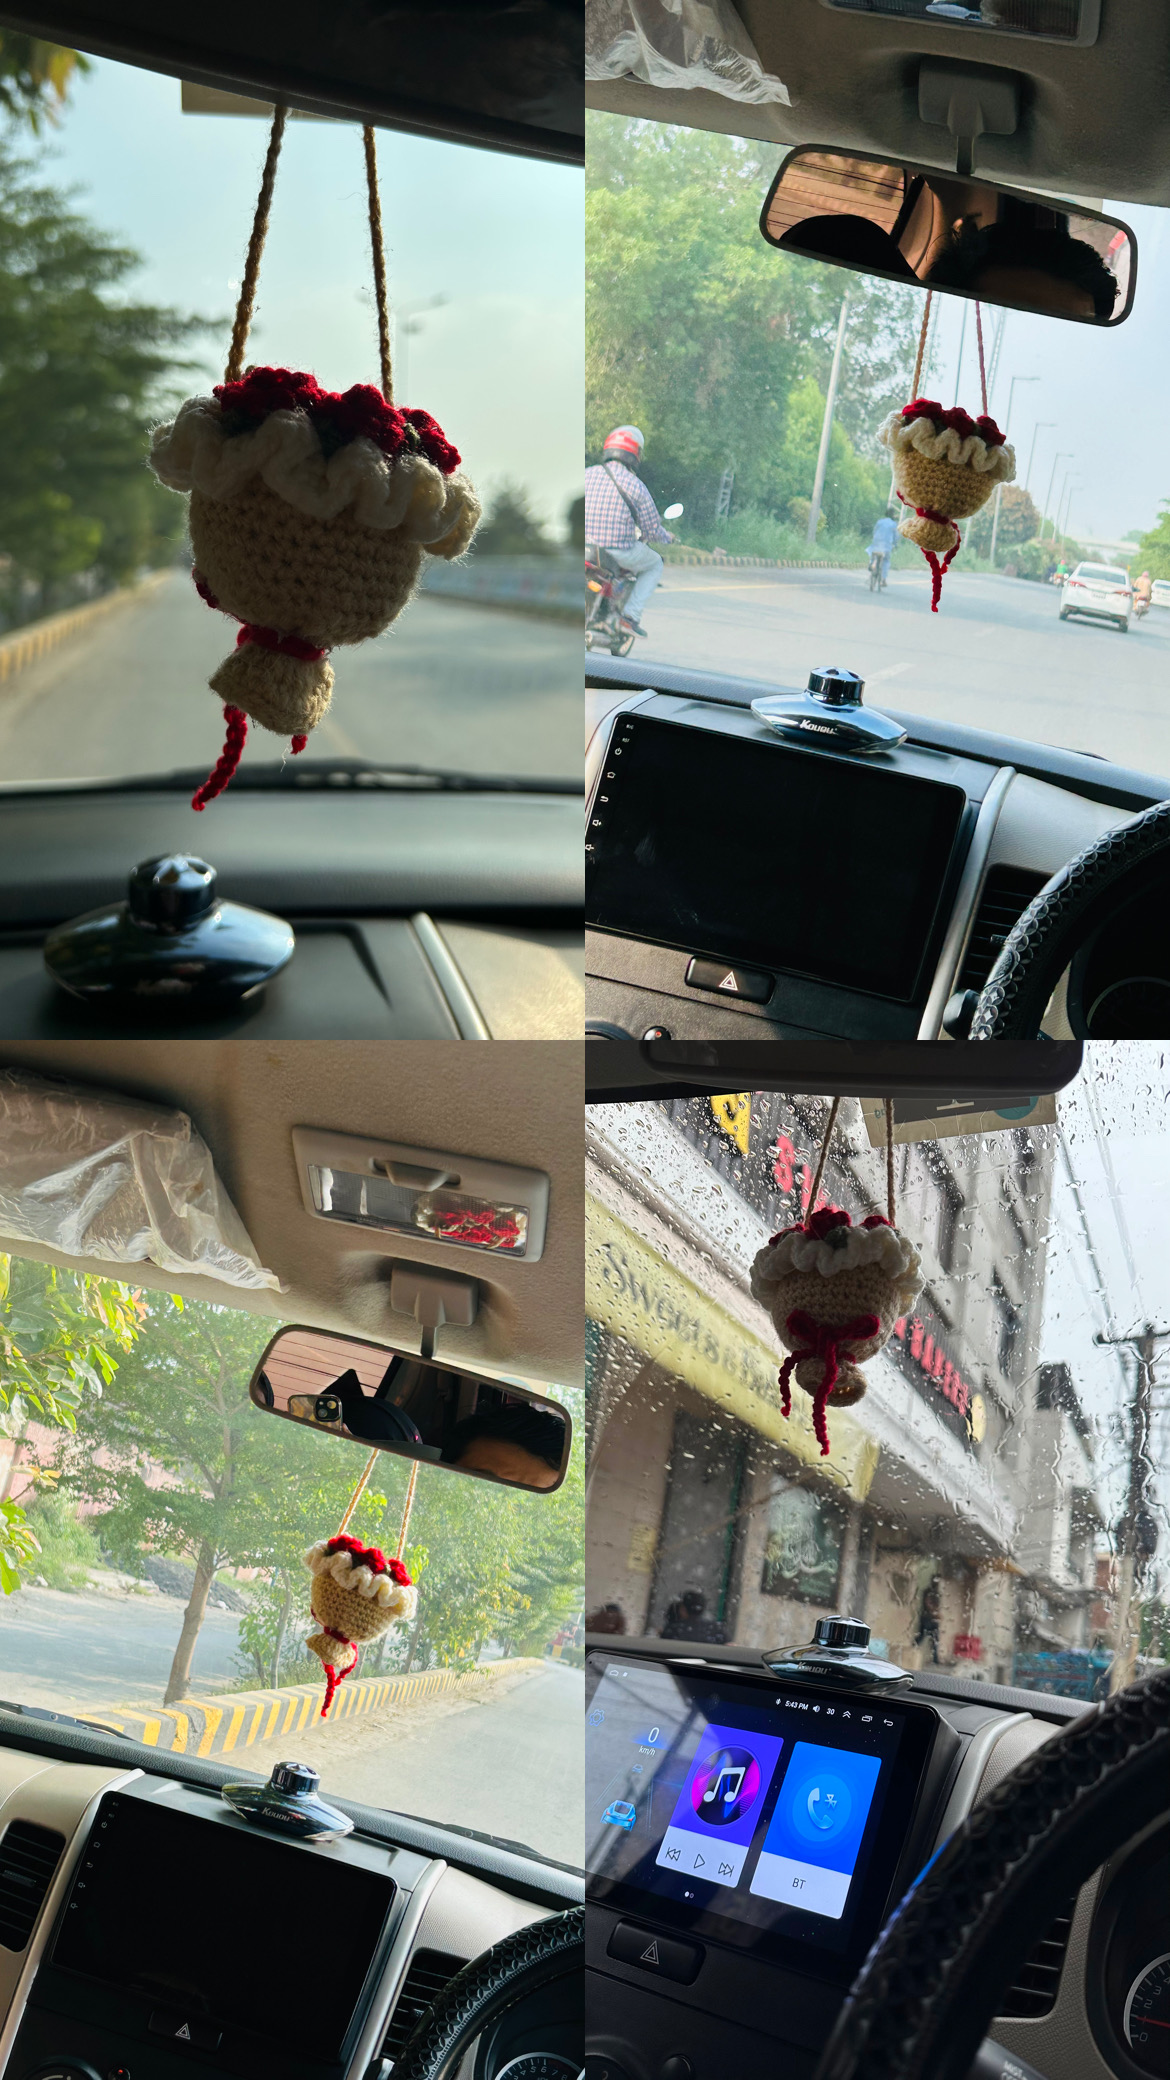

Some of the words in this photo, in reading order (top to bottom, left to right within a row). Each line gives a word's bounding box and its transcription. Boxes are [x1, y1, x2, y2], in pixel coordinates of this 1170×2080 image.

[785, 1700, 798, 1709] 5:43
[798, 1702, 809, 1710] PM
[648, 1727, 660, 1743] 0
[639, 1745, 656, 1756] km/h
[792, 1877, 807, 1889] BT
[1153, 1985, 1162, 1995] 3
[1143, 1998, 1153, 2009] 2
[1139, 2032, 1148, 2042] 0
